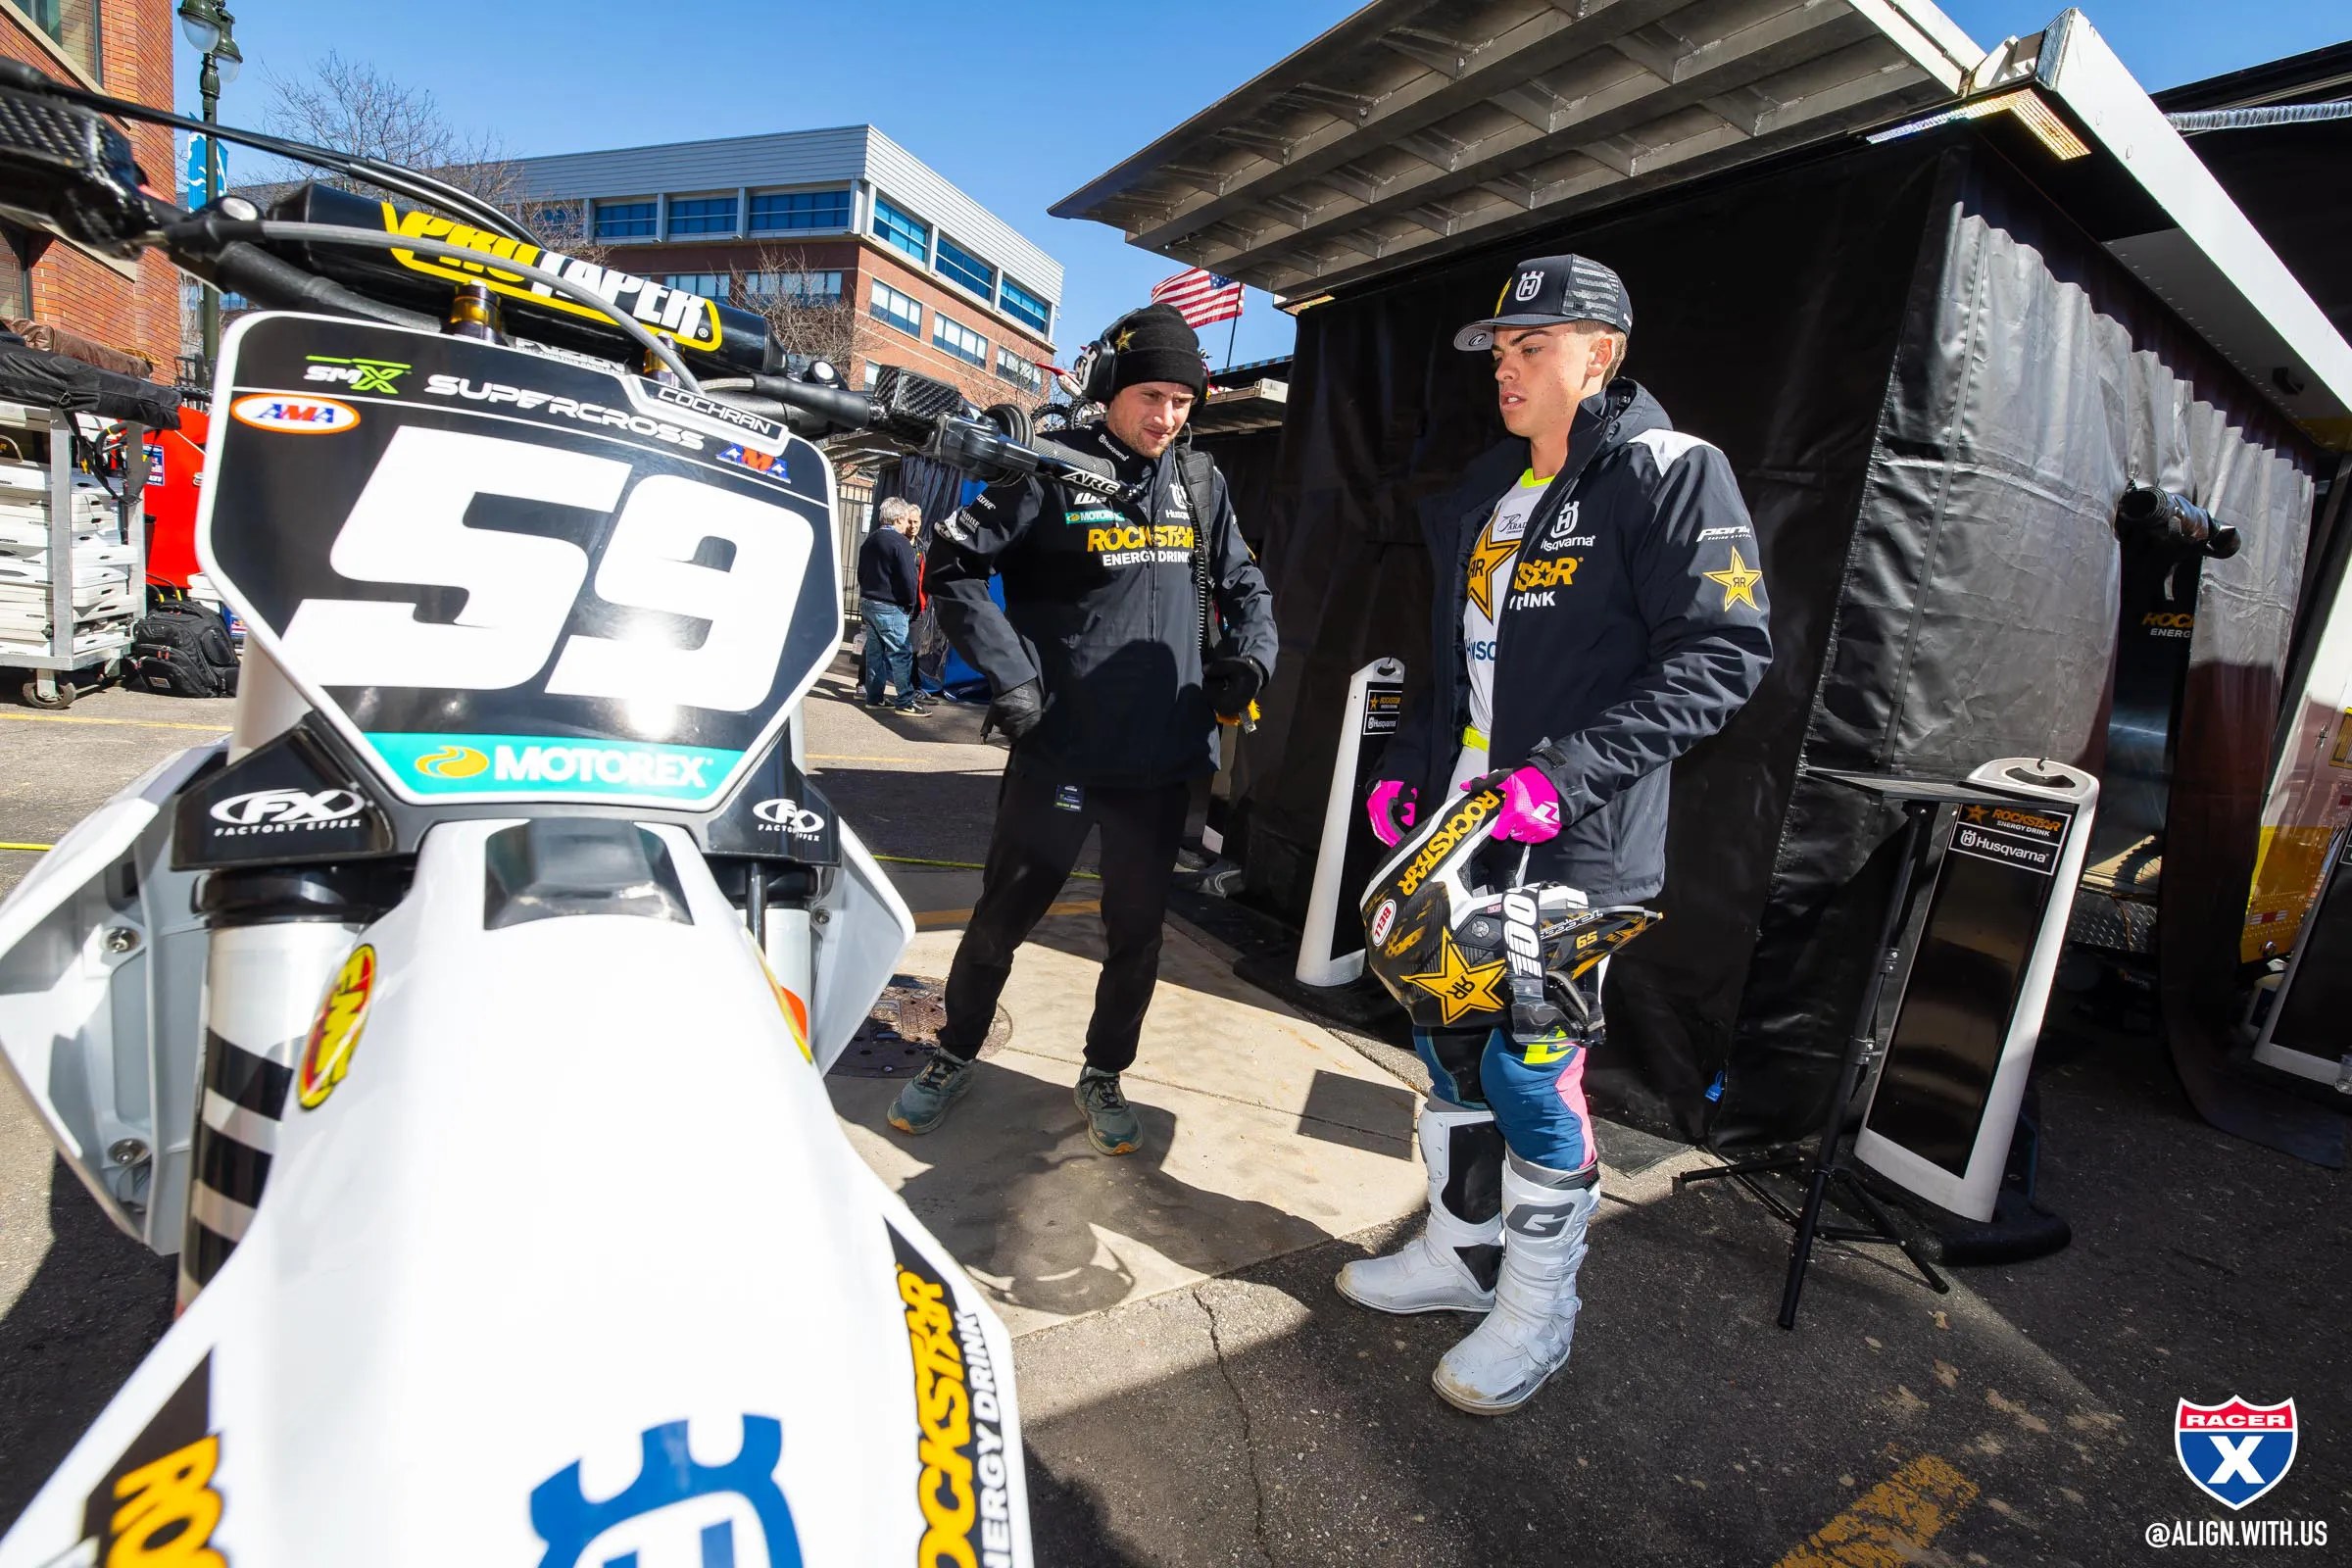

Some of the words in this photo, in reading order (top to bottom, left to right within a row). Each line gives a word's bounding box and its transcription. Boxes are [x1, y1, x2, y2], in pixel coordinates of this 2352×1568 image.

[303, 359, 409, 394] SMX
[252, 403, 335, 423] AMA
[424, 374, 706, 451] SUPERCROSS
[658, 387, 771, 435] COCHRAN
[715, 441, 792, 484] AMA
[1059, 471, 1121, 495] ARC
[280, 425, 816, 712] 59
[1102, 550, 1155, 566] ENERGY
[2150, 628, 2191, 638] ENERG
[495, 745, 707, 789] MOTOREX
[214, 822, 297, 837] FACTORY
[306, 818, 361, 830] EFFEX
[1992, 808, 2062, 832] ROCKSTAR
[1996, 819, 2025, 831] ENERGY
[2026, 827, 2050, 837] DRINK
[1396, 790, 1500, 896] ROCKSTAR
[1976, 837, 2046, 863] Husqvarna
[1374, 906, 1393, 943] BELL
[954, 1310, 1001, 1423] DRINK
[916, 1269, 979, 1568] OCKSTAR
[977, 1423, 1013, 1568] NERGY
